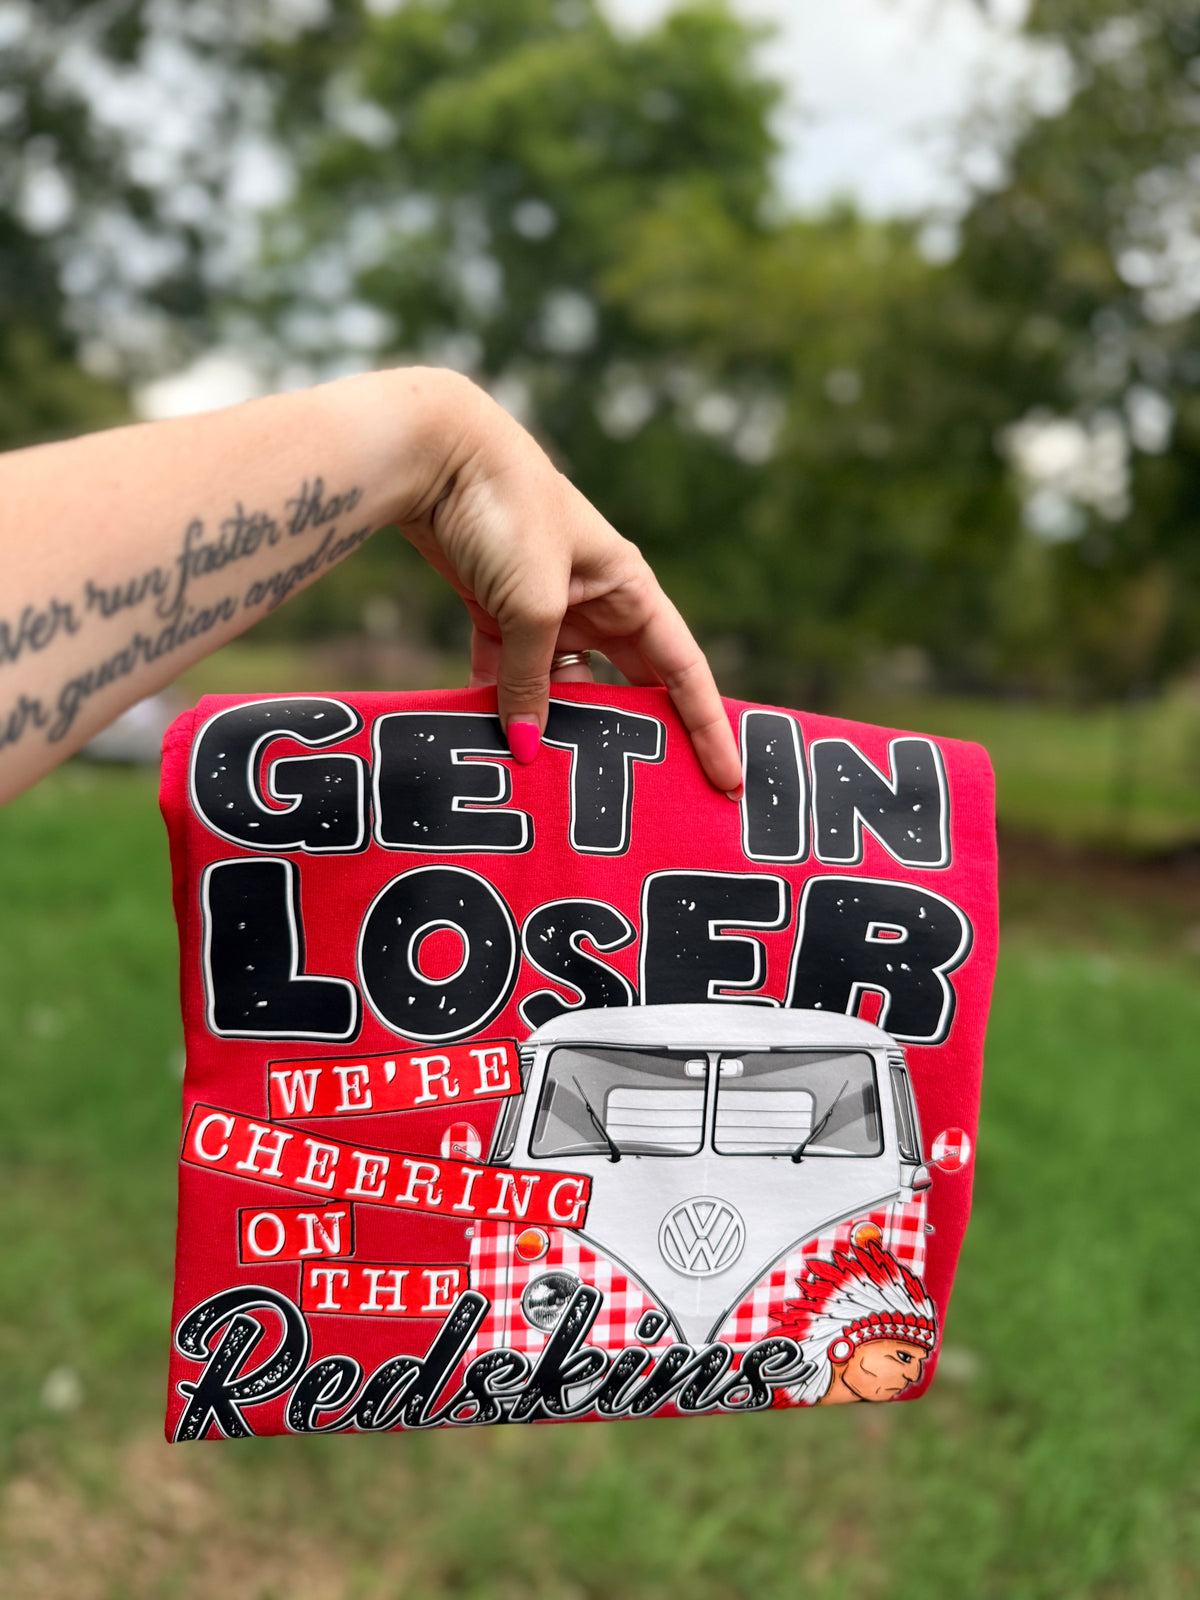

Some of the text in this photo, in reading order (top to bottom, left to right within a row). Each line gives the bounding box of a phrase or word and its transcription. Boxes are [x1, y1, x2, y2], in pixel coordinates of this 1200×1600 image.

[0, 476, 363, 666] ver run faster than
[48, 596, 238, 743] guardian
[188, 697, 952, 869] GET IN
[200, 855, 974, 1045] LOSER
[270, 1046, 512, 1115] WE'RE
[192, 1113, 587, 1224] CHEERING
[246, 1211, 346, 1257] ON
[174, 1284, 818, 1443] Redskins
[309, 1267, 461, 1314] THE
